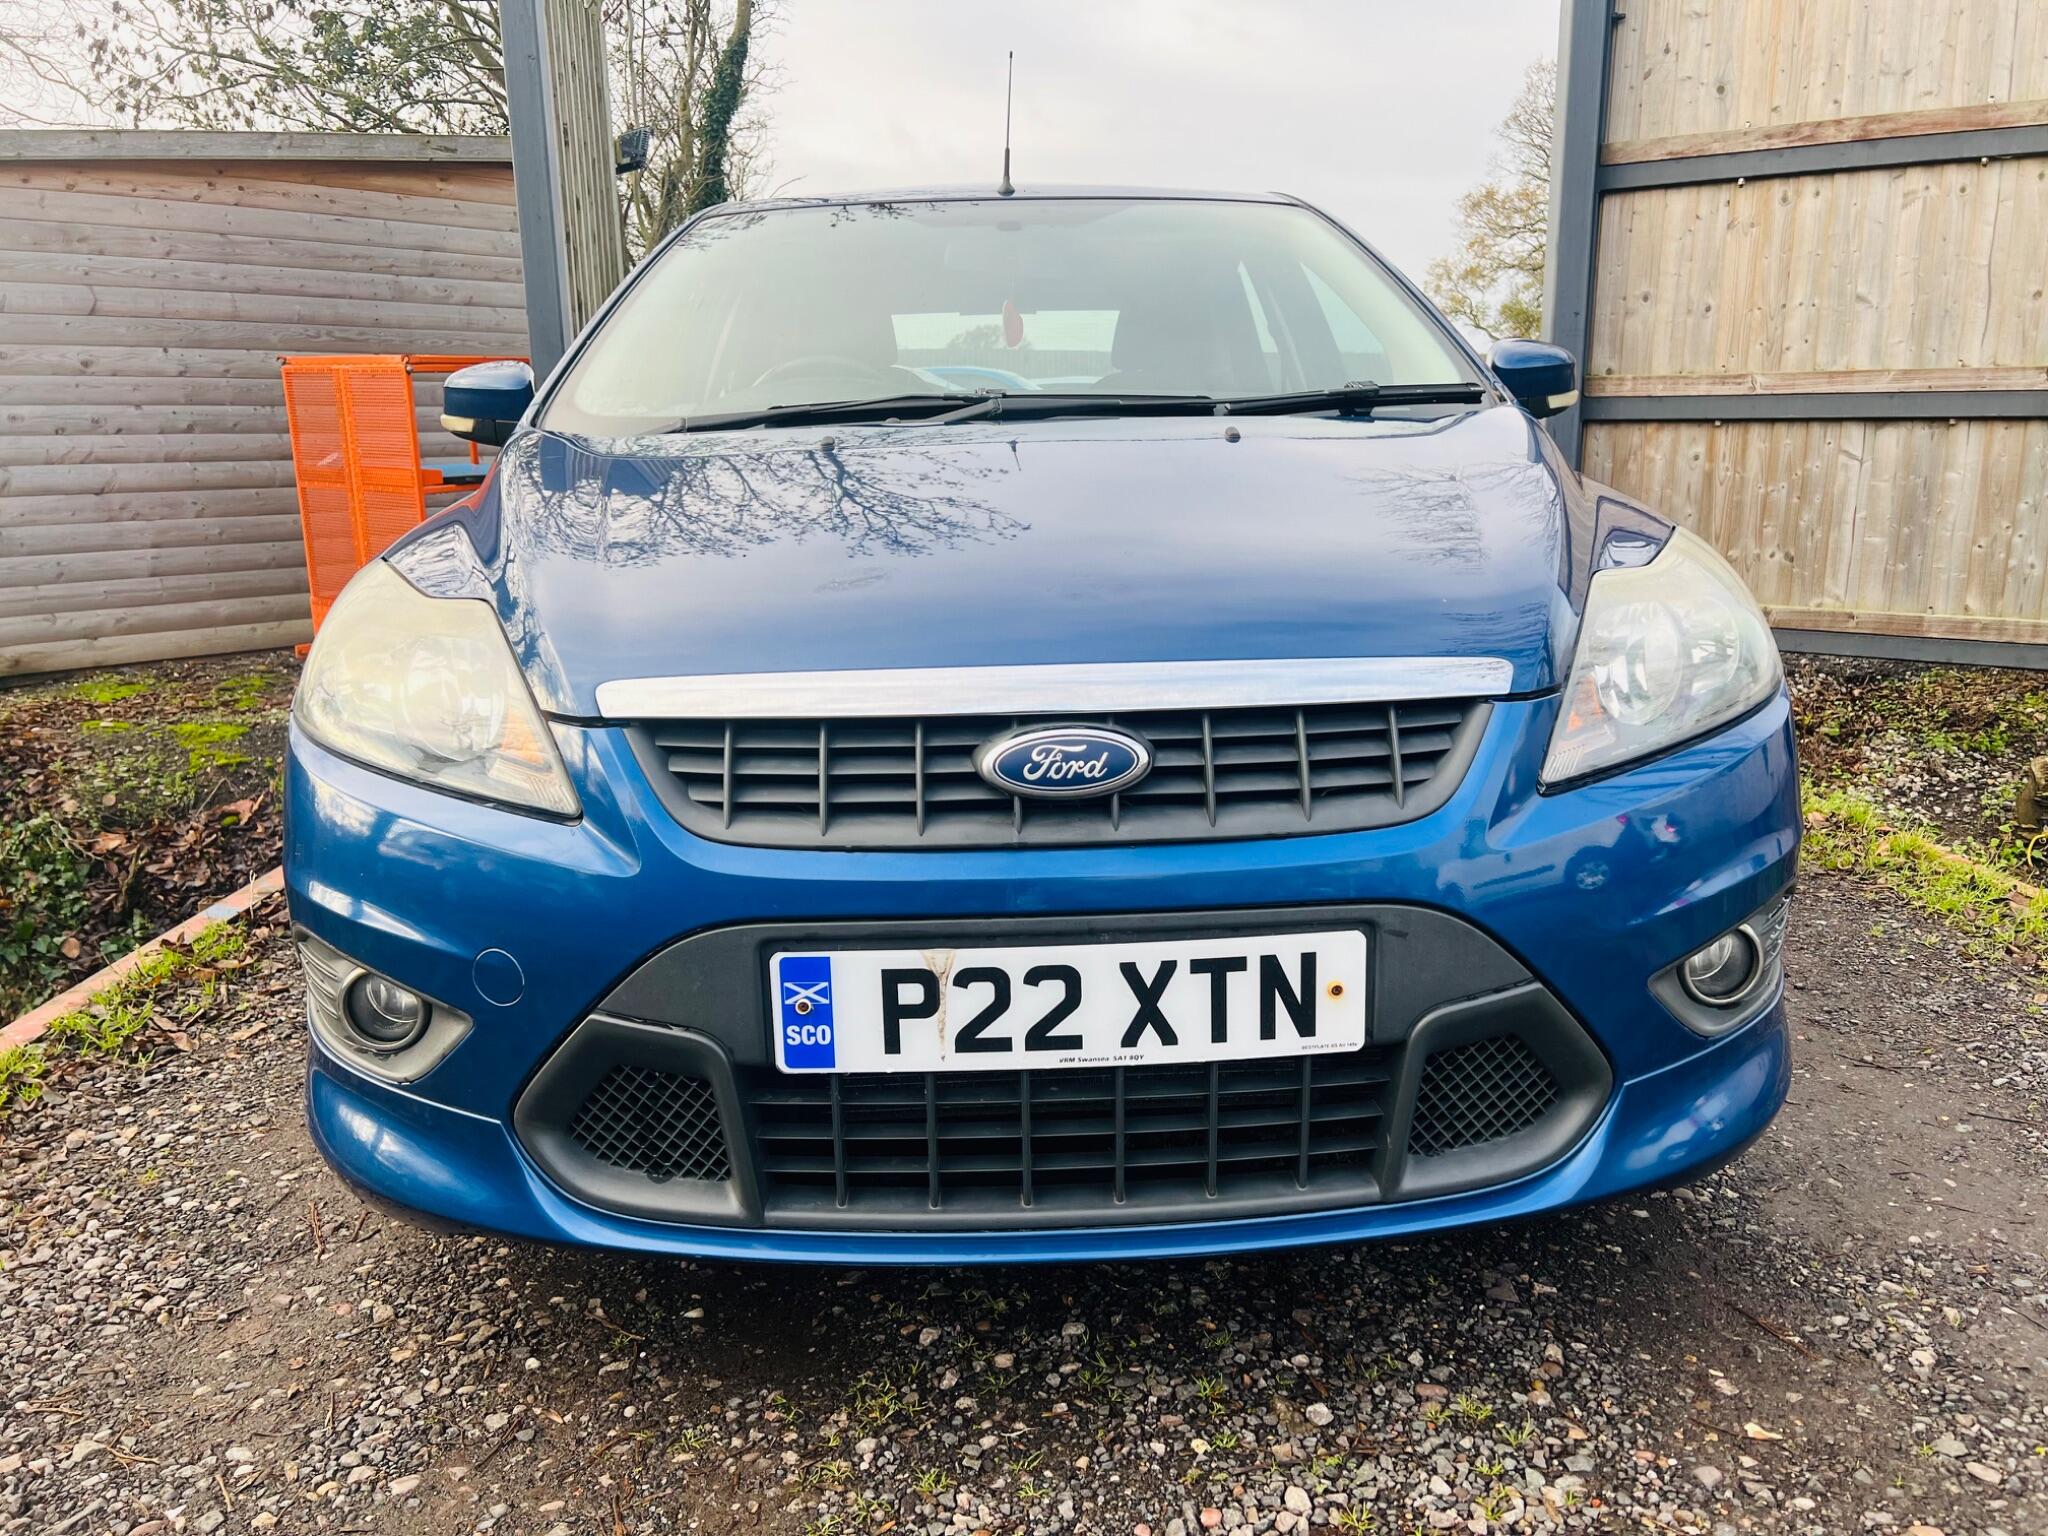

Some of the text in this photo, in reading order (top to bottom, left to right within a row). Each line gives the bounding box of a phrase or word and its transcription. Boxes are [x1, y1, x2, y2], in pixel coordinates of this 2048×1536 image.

[1022, 744, 1109, 781] Ford
[880, 951, 1317, 1055] P22 XTN
[786, 1024, 832, 1046] SCO
